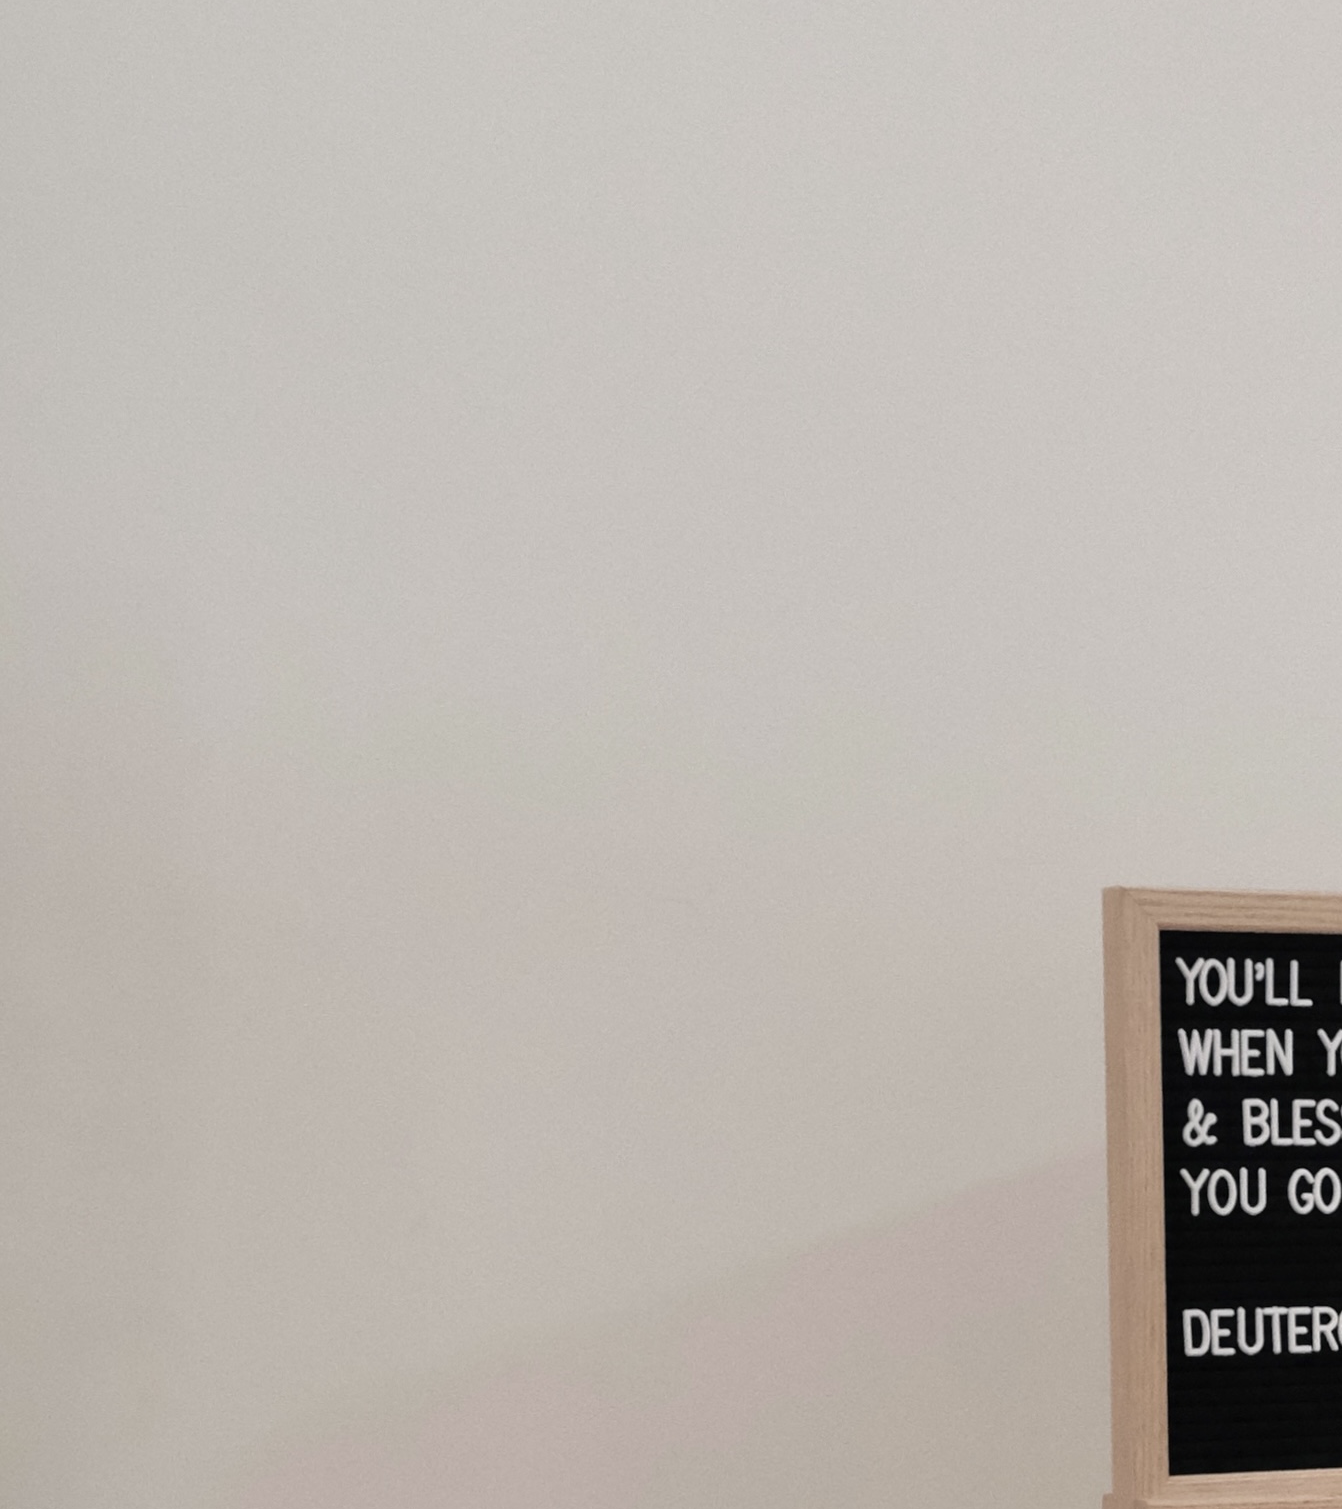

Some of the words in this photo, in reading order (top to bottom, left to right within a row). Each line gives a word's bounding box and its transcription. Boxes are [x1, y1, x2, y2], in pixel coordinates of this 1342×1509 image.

[1176, 957, 1312, 1007] YOU'LL
[1178, 1028, 1293, 1077] WHEN
[1183, 1099, 1217, 1147] &
[1180, 1167, 1266, 1215] YOU
[1287, 1167, 1341, 1214] GO
